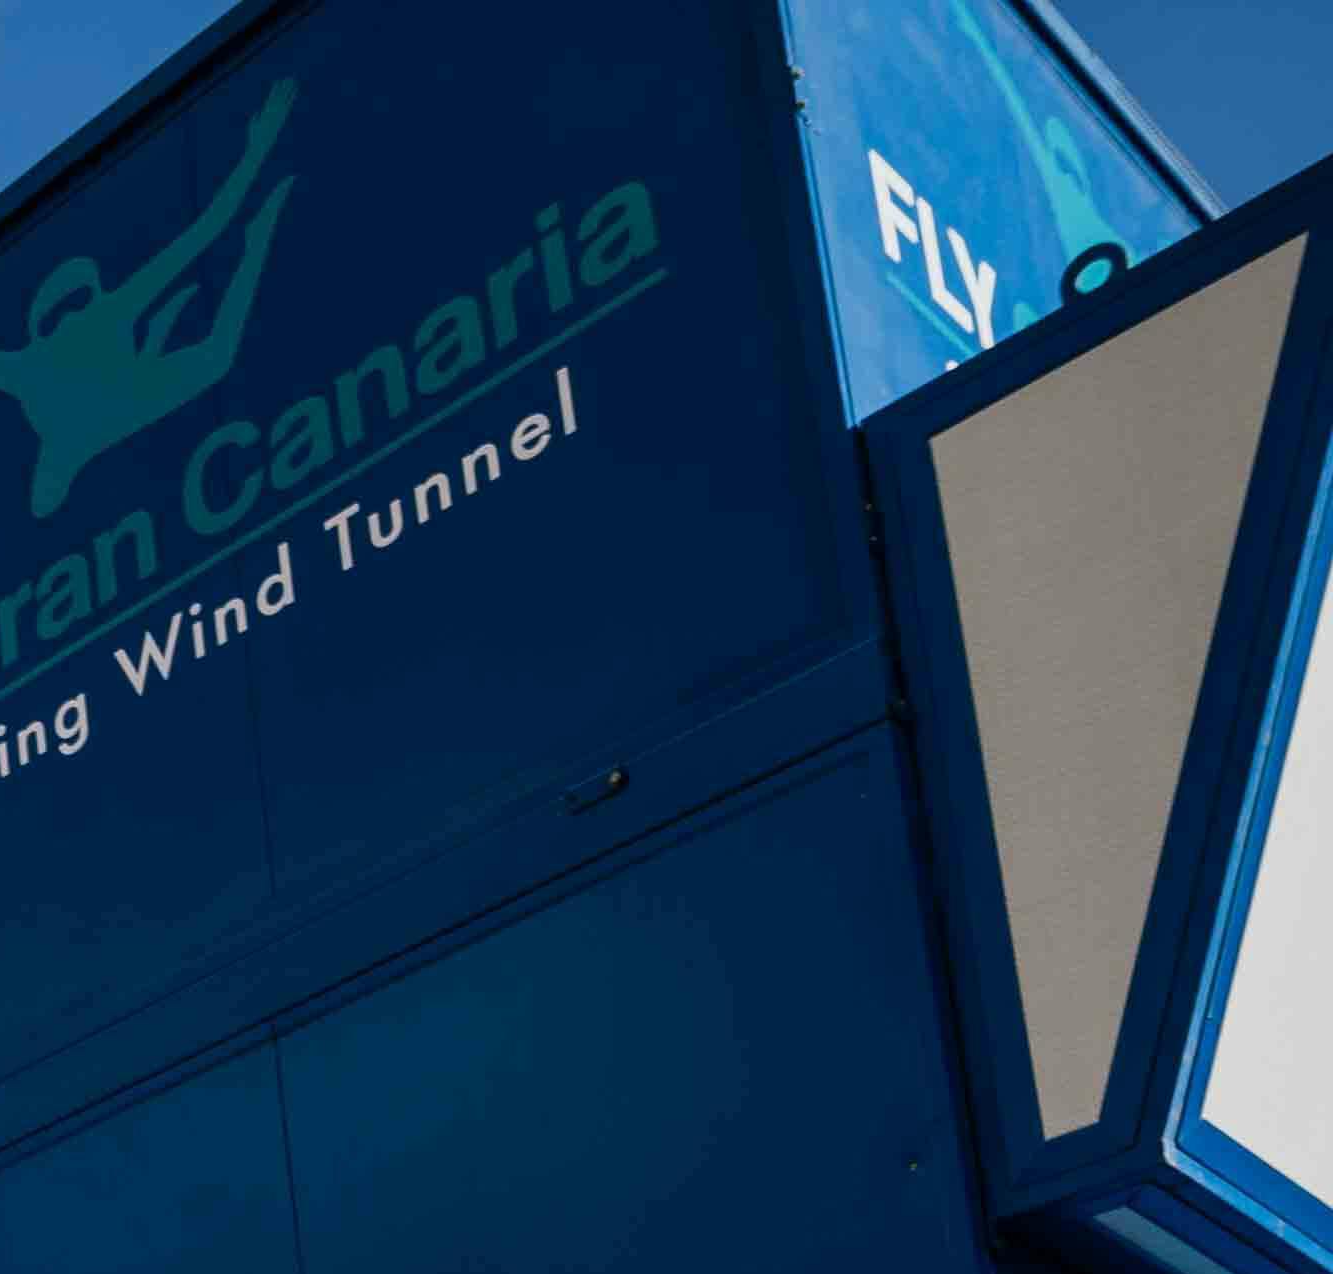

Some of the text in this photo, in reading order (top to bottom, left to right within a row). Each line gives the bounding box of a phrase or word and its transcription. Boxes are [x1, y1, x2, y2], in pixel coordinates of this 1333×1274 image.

[182, 183, 657, 534] Canaria
[868, 149, 996, 350] FLY
[113, 542, 296, 697] Wind
[323, 366, 578, 572] Tunnel
